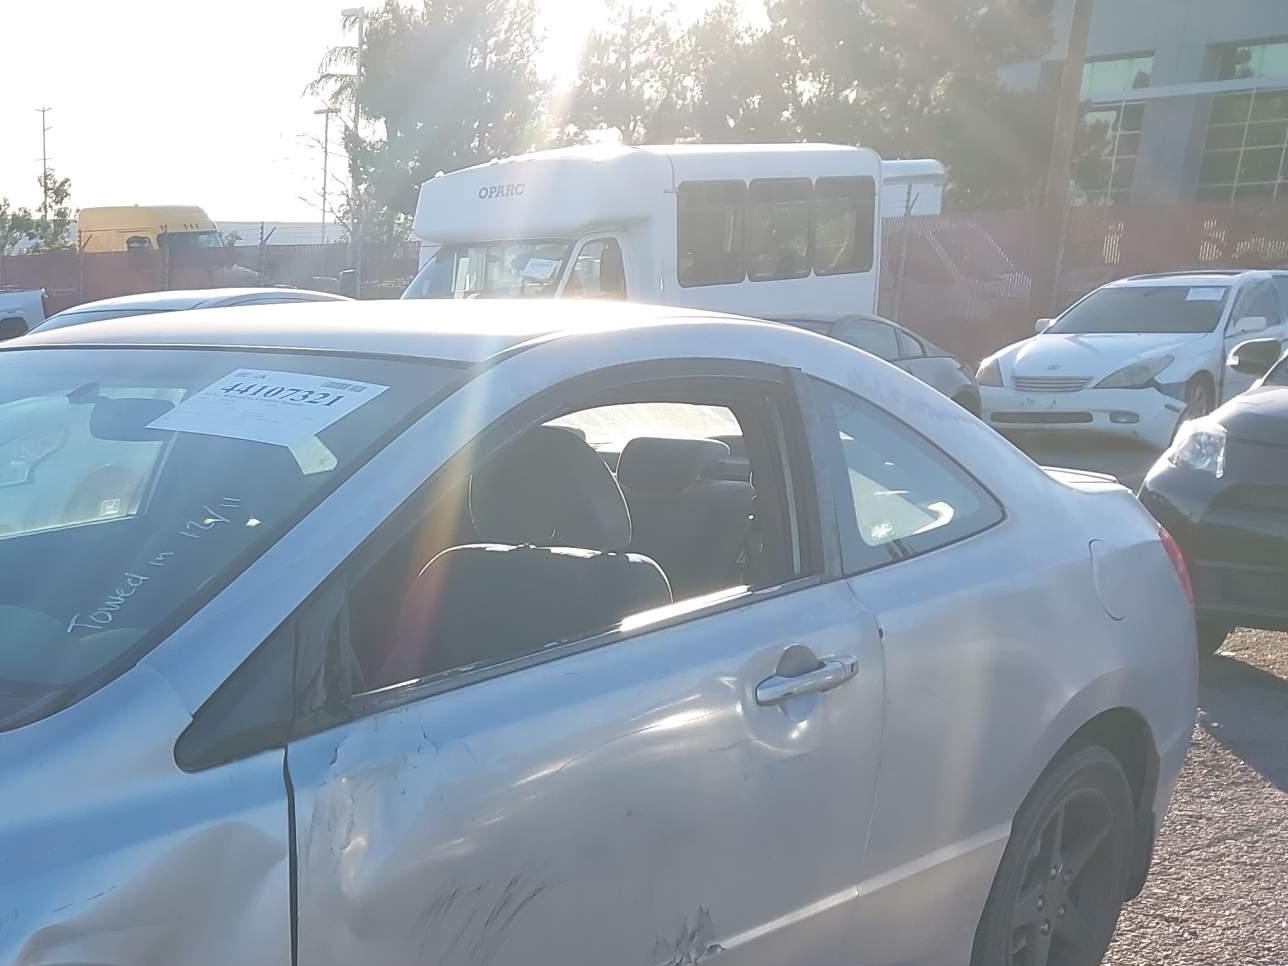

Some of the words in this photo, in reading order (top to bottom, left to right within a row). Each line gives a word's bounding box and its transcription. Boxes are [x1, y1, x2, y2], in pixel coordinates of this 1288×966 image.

[478, 183, 526, 199] OPARC
[220, 381, 346, 407] 44107321
[66, 572, 151, 633] Towed
[148, 550, 176, 567] in
